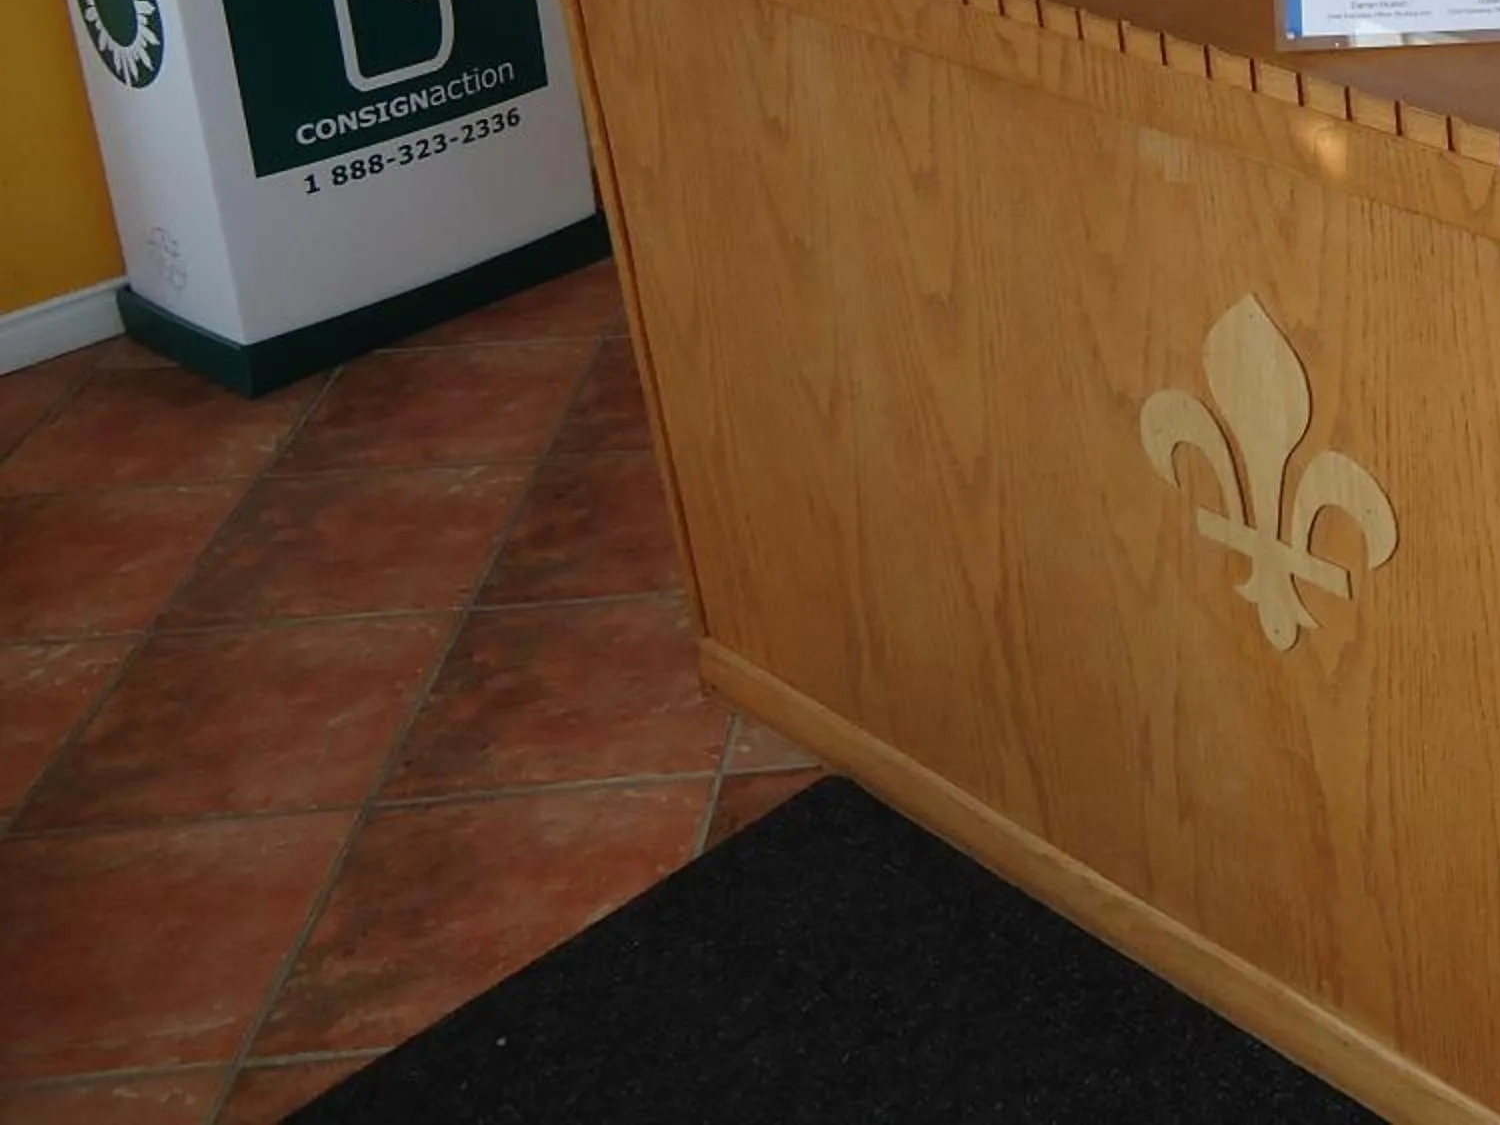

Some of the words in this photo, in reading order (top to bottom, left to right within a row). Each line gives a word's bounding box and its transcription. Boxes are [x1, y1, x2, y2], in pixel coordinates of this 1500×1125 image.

[295, 61, 515, 145] CONSIGNaction
[304, 174, 320, 195] 1
[331, 107, 521, 186] 888-323-2336
